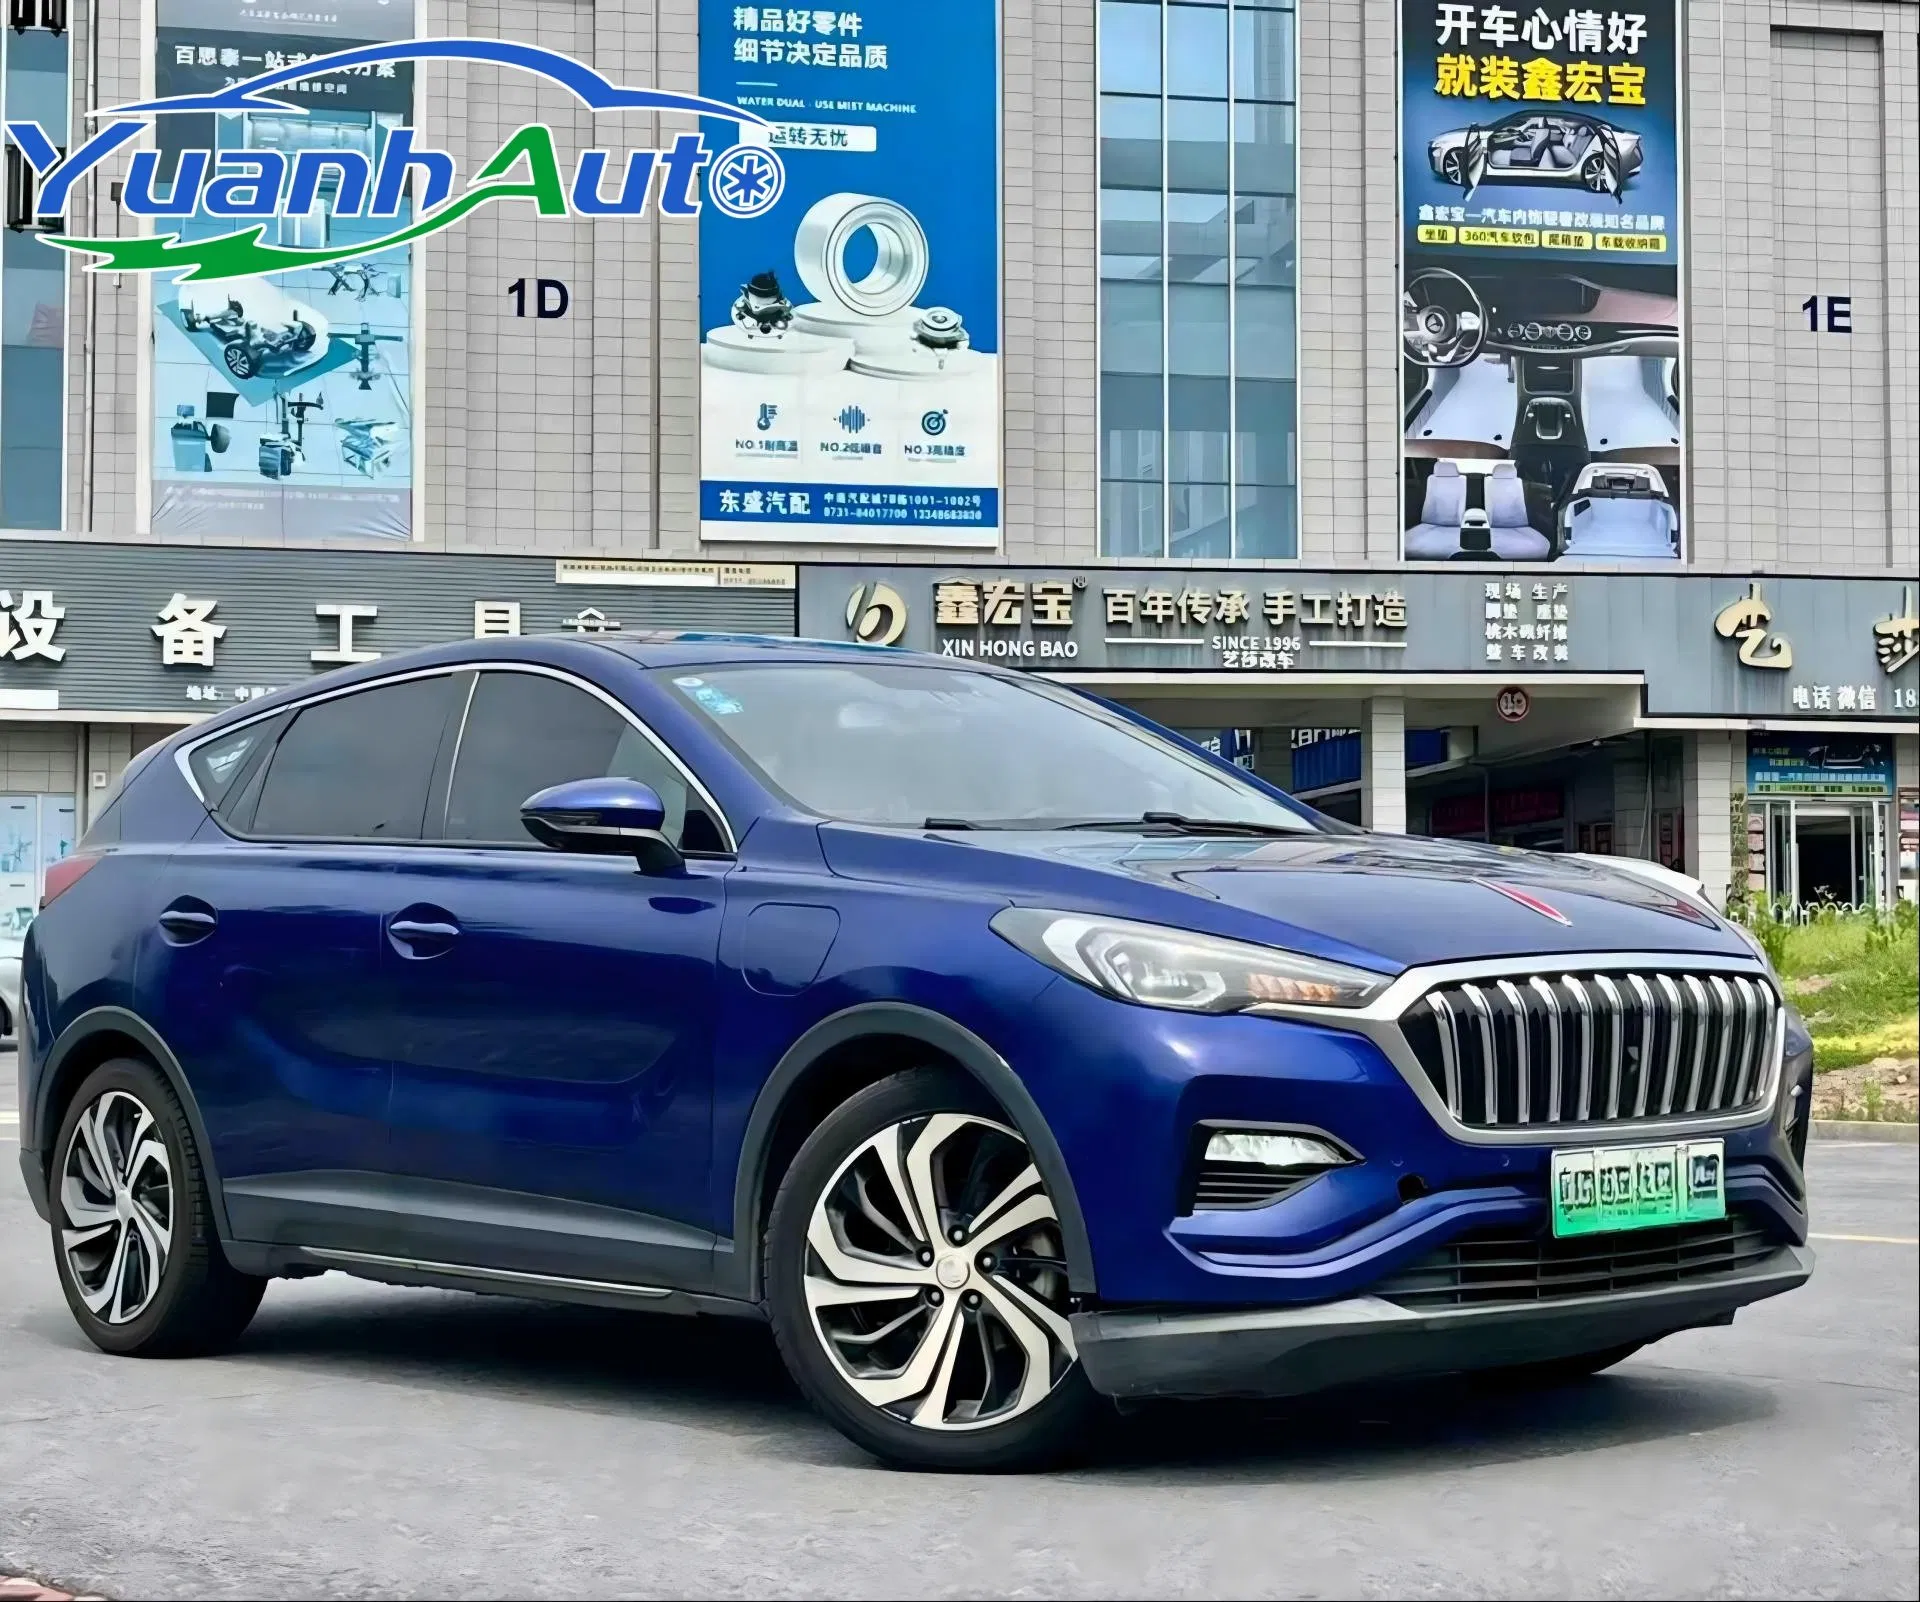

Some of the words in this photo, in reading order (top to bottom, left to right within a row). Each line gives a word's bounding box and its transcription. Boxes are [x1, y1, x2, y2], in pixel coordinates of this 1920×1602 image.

[733, 7, 863, 37] 精品好零件
[1435, 3, 1648, 54] 开车心情好
[733, 38, 889, 70] 细节决定品质
[1434, 53, 1646, 105] 就装鑫宏宝
[737, 96, 774, 106] WATER
[776, 98, 805, 108] DUAL
[866, 102, 917, 114] MACHINE
[508, 278, 569, 319] 1D
[1802, 295, 1852, 333] 1E
[719, 489, 811, 515] 东盛汽配
[934, 578, 1073, 625] 鑫宏宝
[1485, 582, 1521, 600] 现场
[1532, 582, 1568, 600] 生产
[1103, 588, 1250, 625] 百年传承
[1262, 588, 1408, 628] 手工打造
[942, 639, 976, 657] XIN
[979, 640, 1035, 657] HONG
[1040, 641, 1079, 658] BAO
[1211, 635, 1259, 650] SINCE
[1264, 636, 1301, 650] 1996
[1792, 684, 1831, 710] 电话
[1837, 684, 1877, 710] 微信
